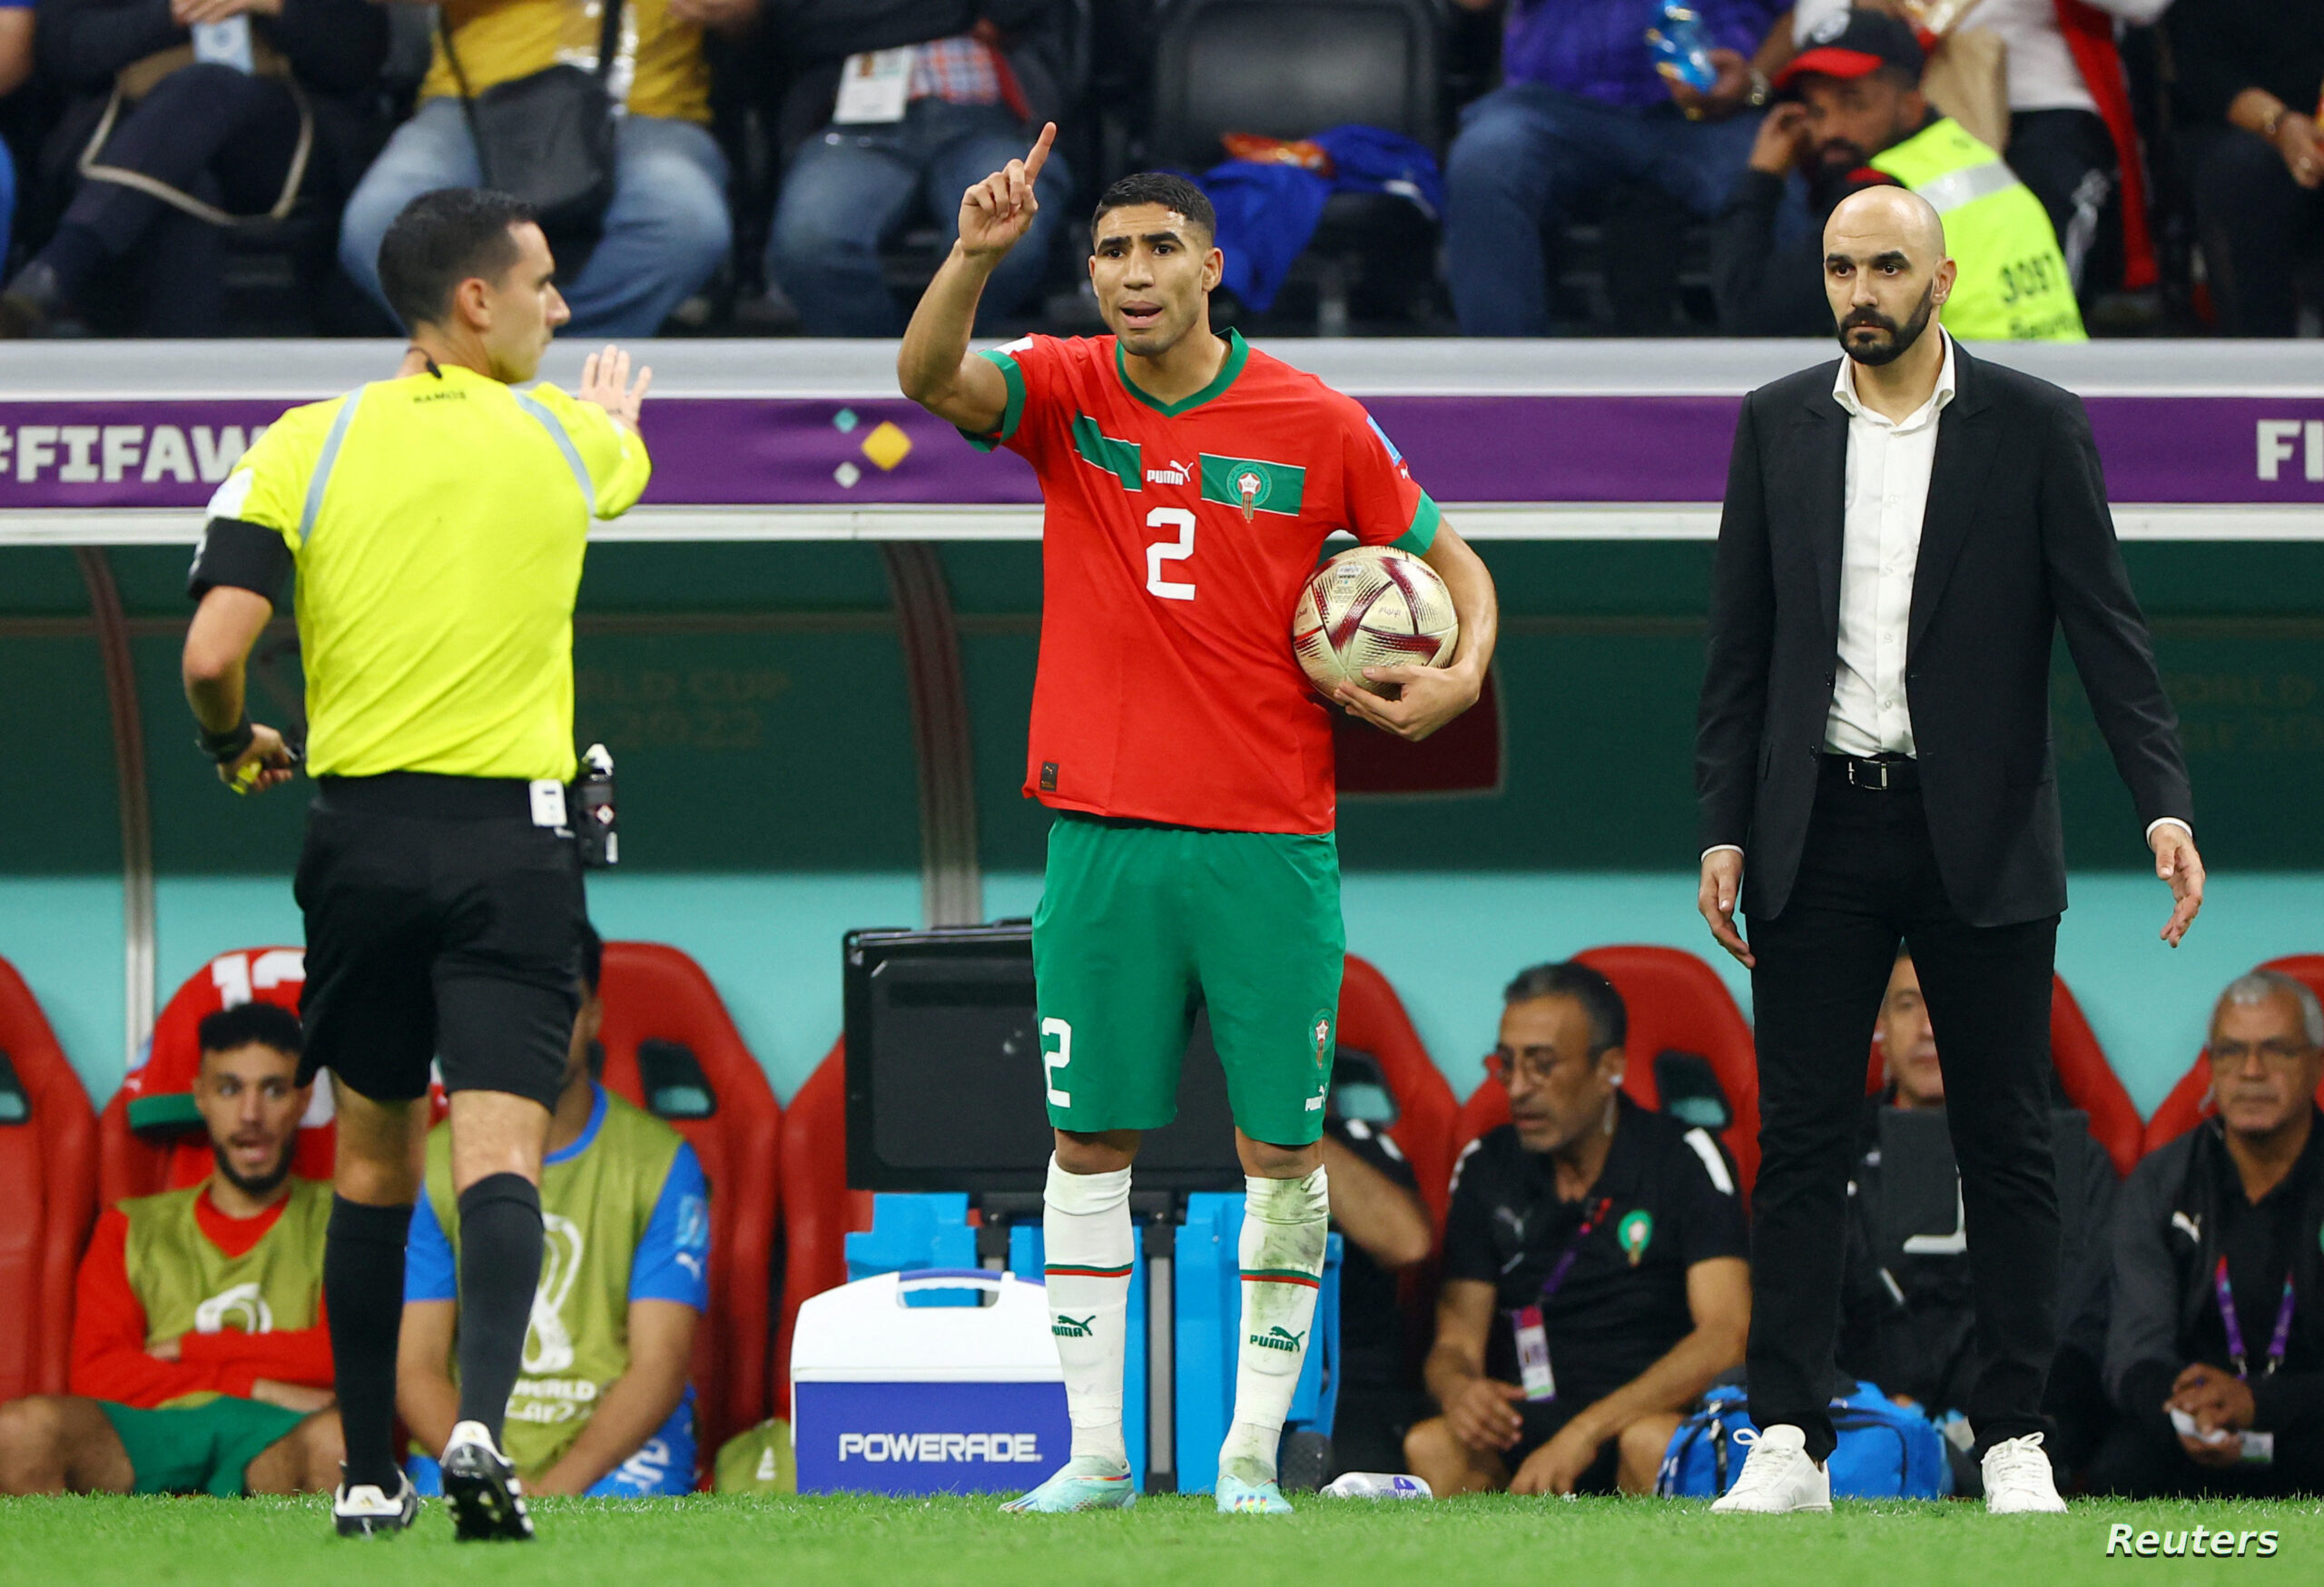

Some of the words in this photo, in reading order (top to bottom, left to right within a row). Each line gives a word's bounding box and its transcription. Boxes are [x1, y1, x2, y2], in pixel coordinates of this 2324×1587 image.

[1147, 468, 1184, 486] PUMA
[1146, 506, 1196, 601] 2
[1041, 1016, 1072, 1109] 2
[1249, 1334, 1295, 1353] PUMA
[839, 1433, 1037, 1463] POWERADE
